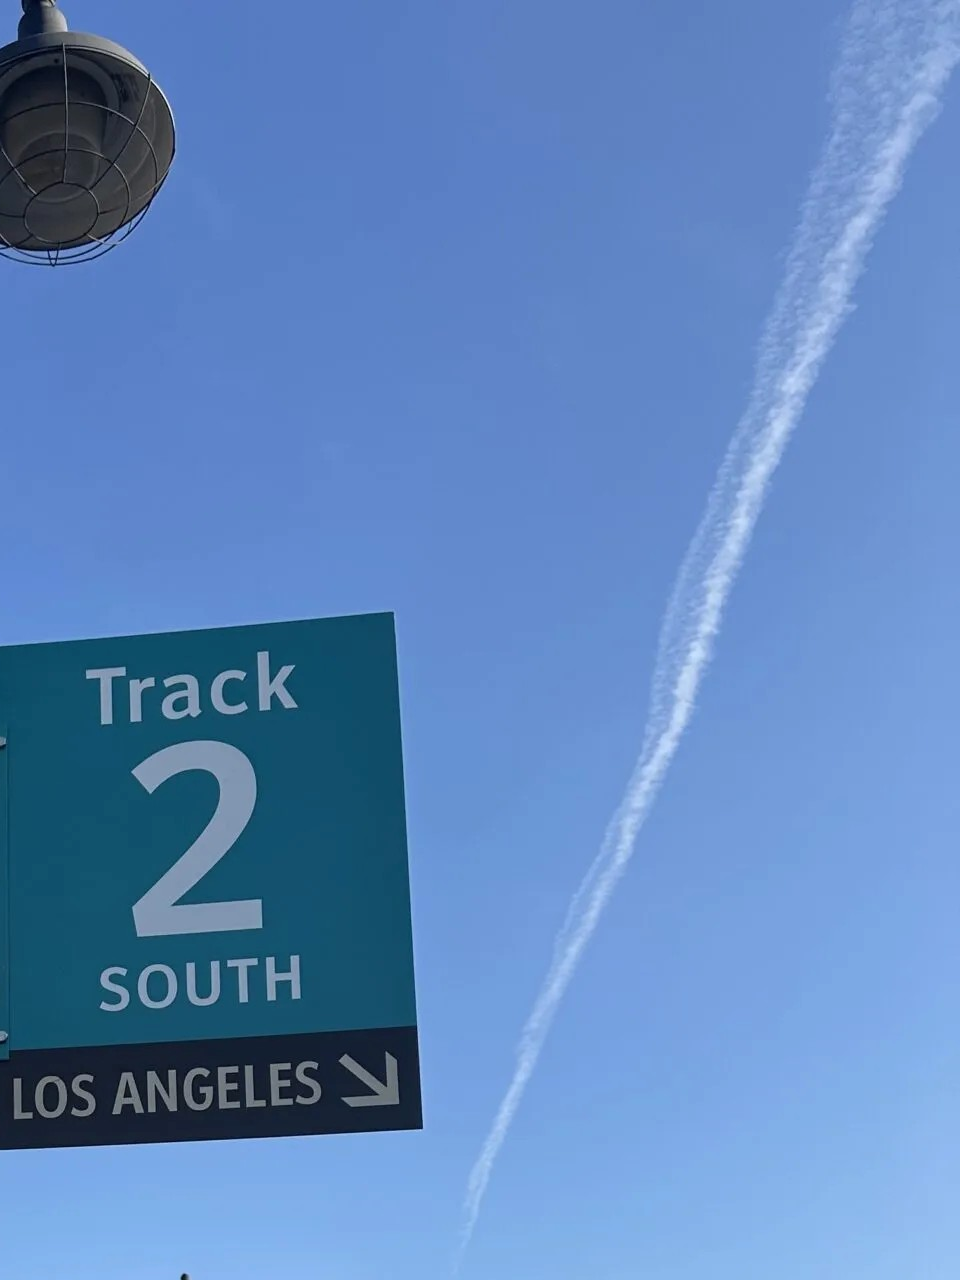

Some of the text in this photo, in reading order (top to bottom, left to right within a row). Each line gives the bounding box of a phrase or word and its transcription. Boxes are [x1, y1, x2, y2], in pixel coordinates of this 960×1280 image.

[86, 651, 297, 724] Track
[131, 741, 262, 937] 2
[100, 955, 300, 1011] SOUTH
[14, 1061, 321, 1119] LOS ANGELES
